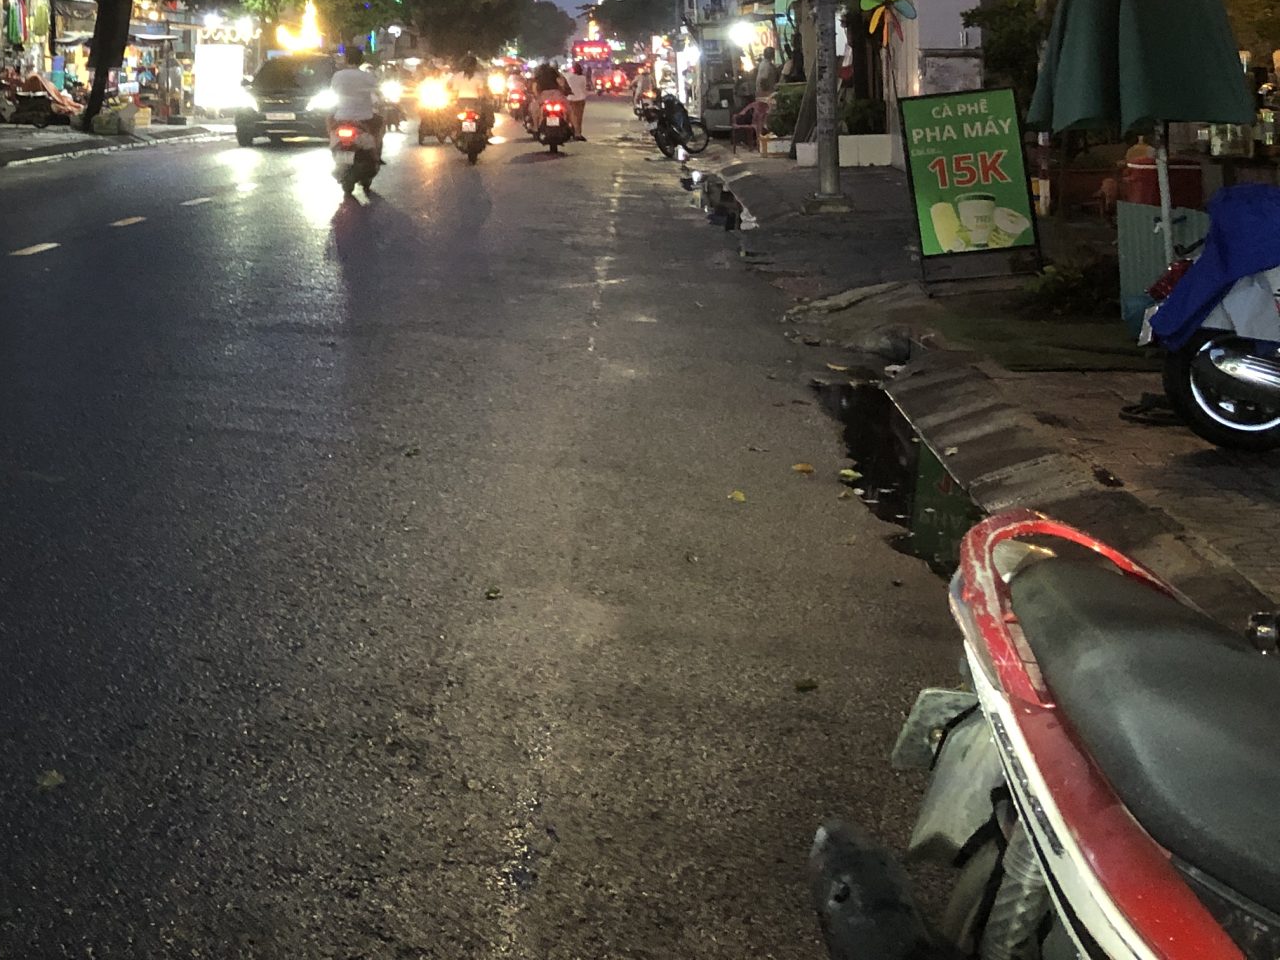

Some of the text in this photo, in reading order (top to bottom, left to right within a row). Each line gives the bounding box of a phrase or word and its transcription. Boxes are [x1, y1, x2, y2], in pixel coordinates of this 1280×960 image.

[931, 102, 953, 119] CÀ
[911, 115, 1012, 145] PHA MÁY
[927, 149, 1012, 190] 15K
